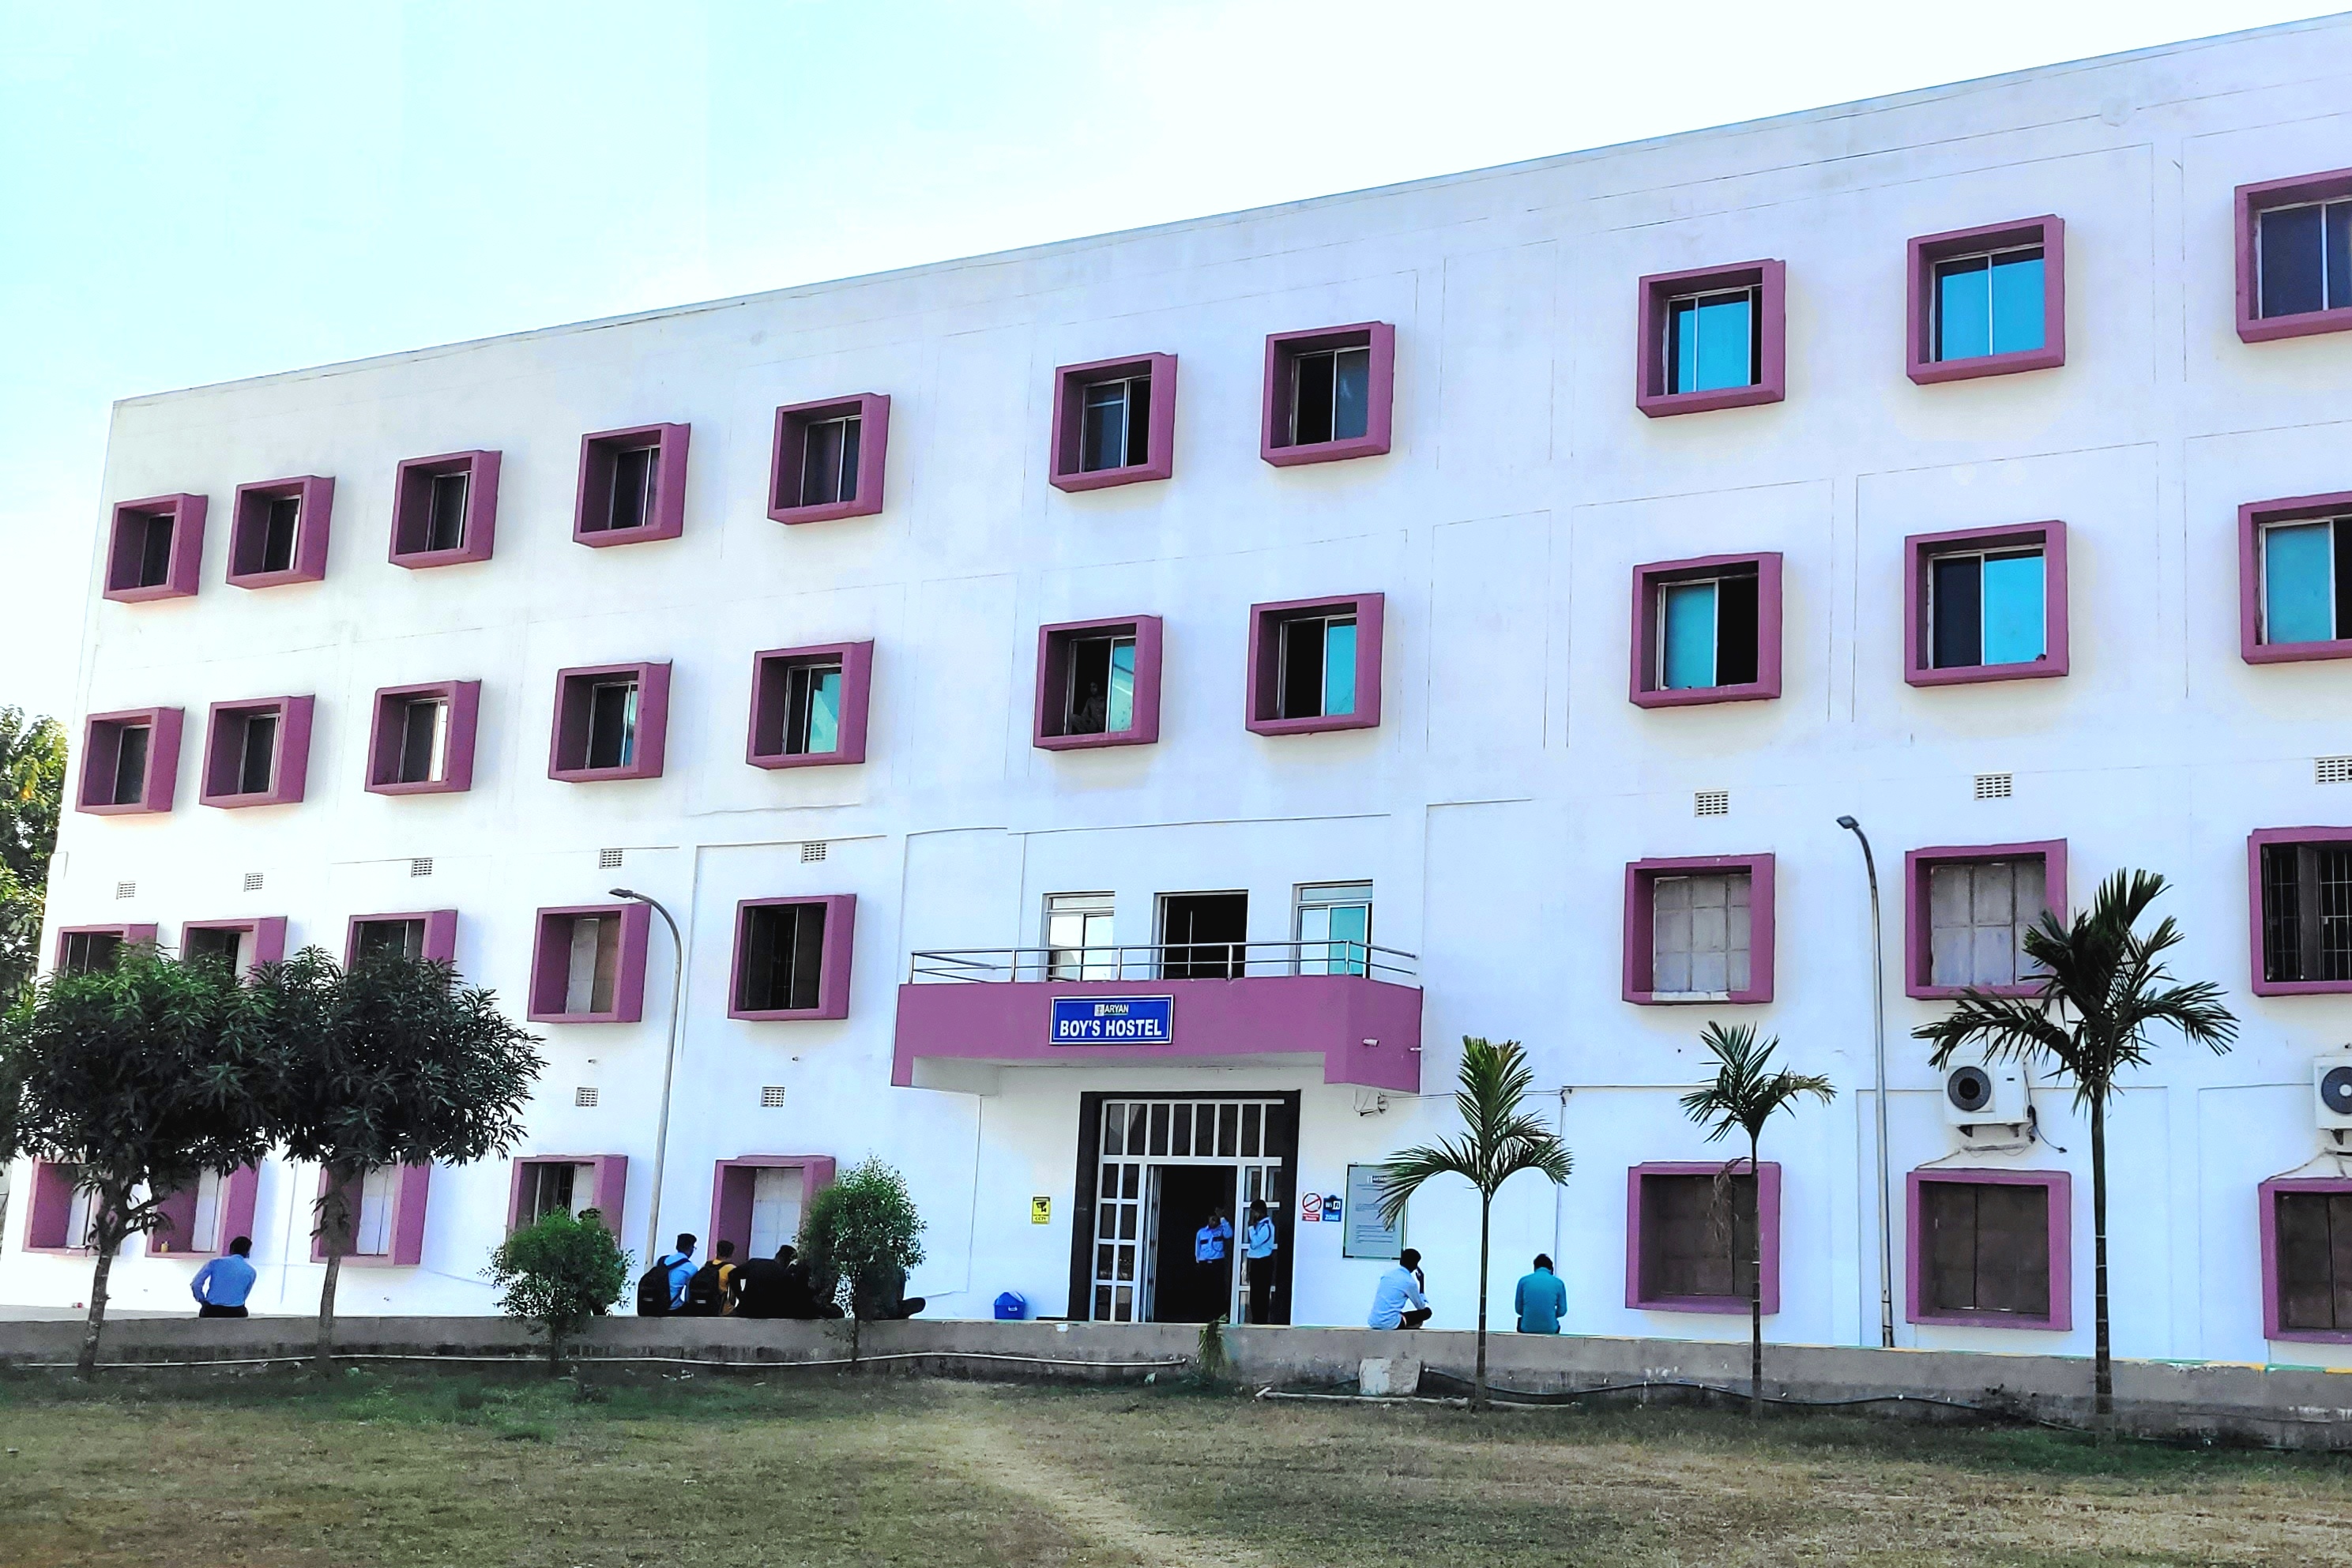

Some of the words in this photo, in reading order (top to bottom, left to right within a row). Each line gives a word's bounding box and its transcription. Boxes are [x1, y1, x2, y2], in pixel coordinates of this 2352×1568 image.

[1104, 1004, 1129, 1013] ARYAN
[1059, 1020, 1101, 1037] BOY'S
[1105, 1019, 1162, 1036] HOSTEL
